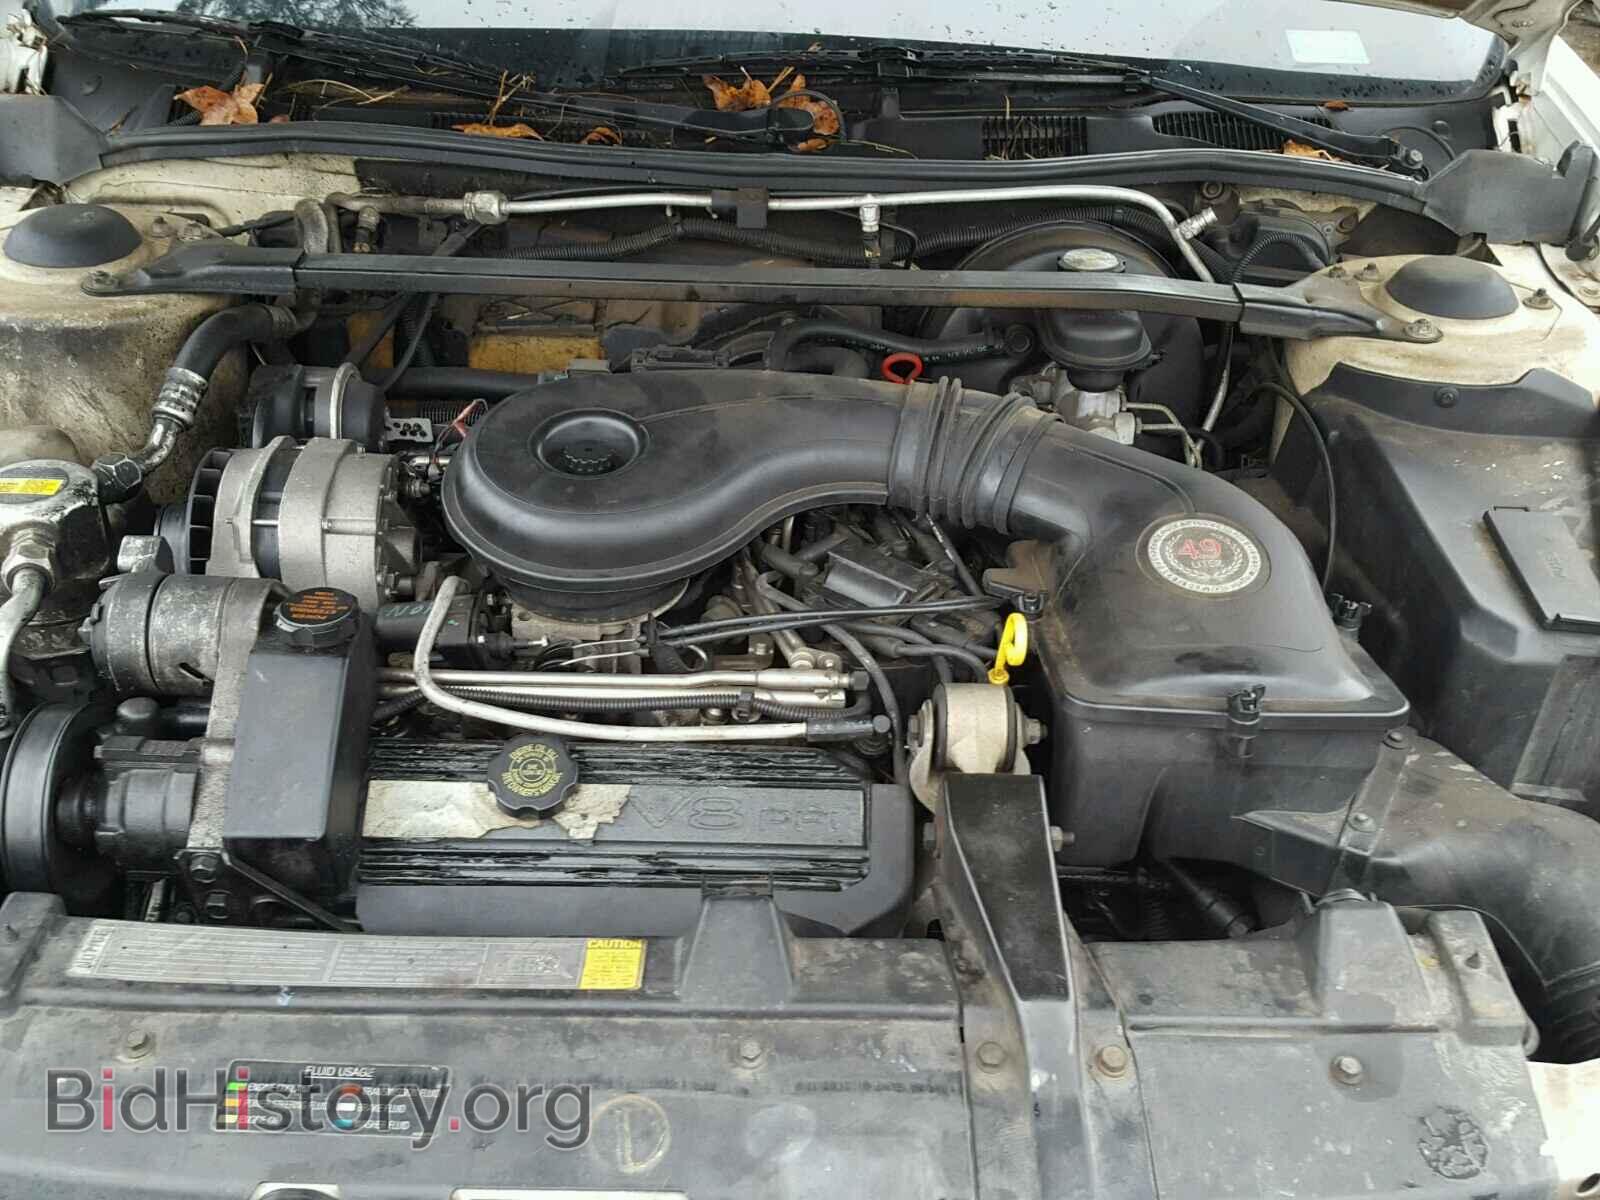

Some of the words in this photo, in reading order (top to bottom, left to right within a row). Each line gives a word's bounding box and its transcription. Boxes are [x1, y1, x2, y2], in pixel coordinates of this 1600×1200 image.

[587, 939, 643, 949] CAUTION
[304, 1065, 336, 1077] FLUID
[338, 1066, 377, 1078] USAGE
